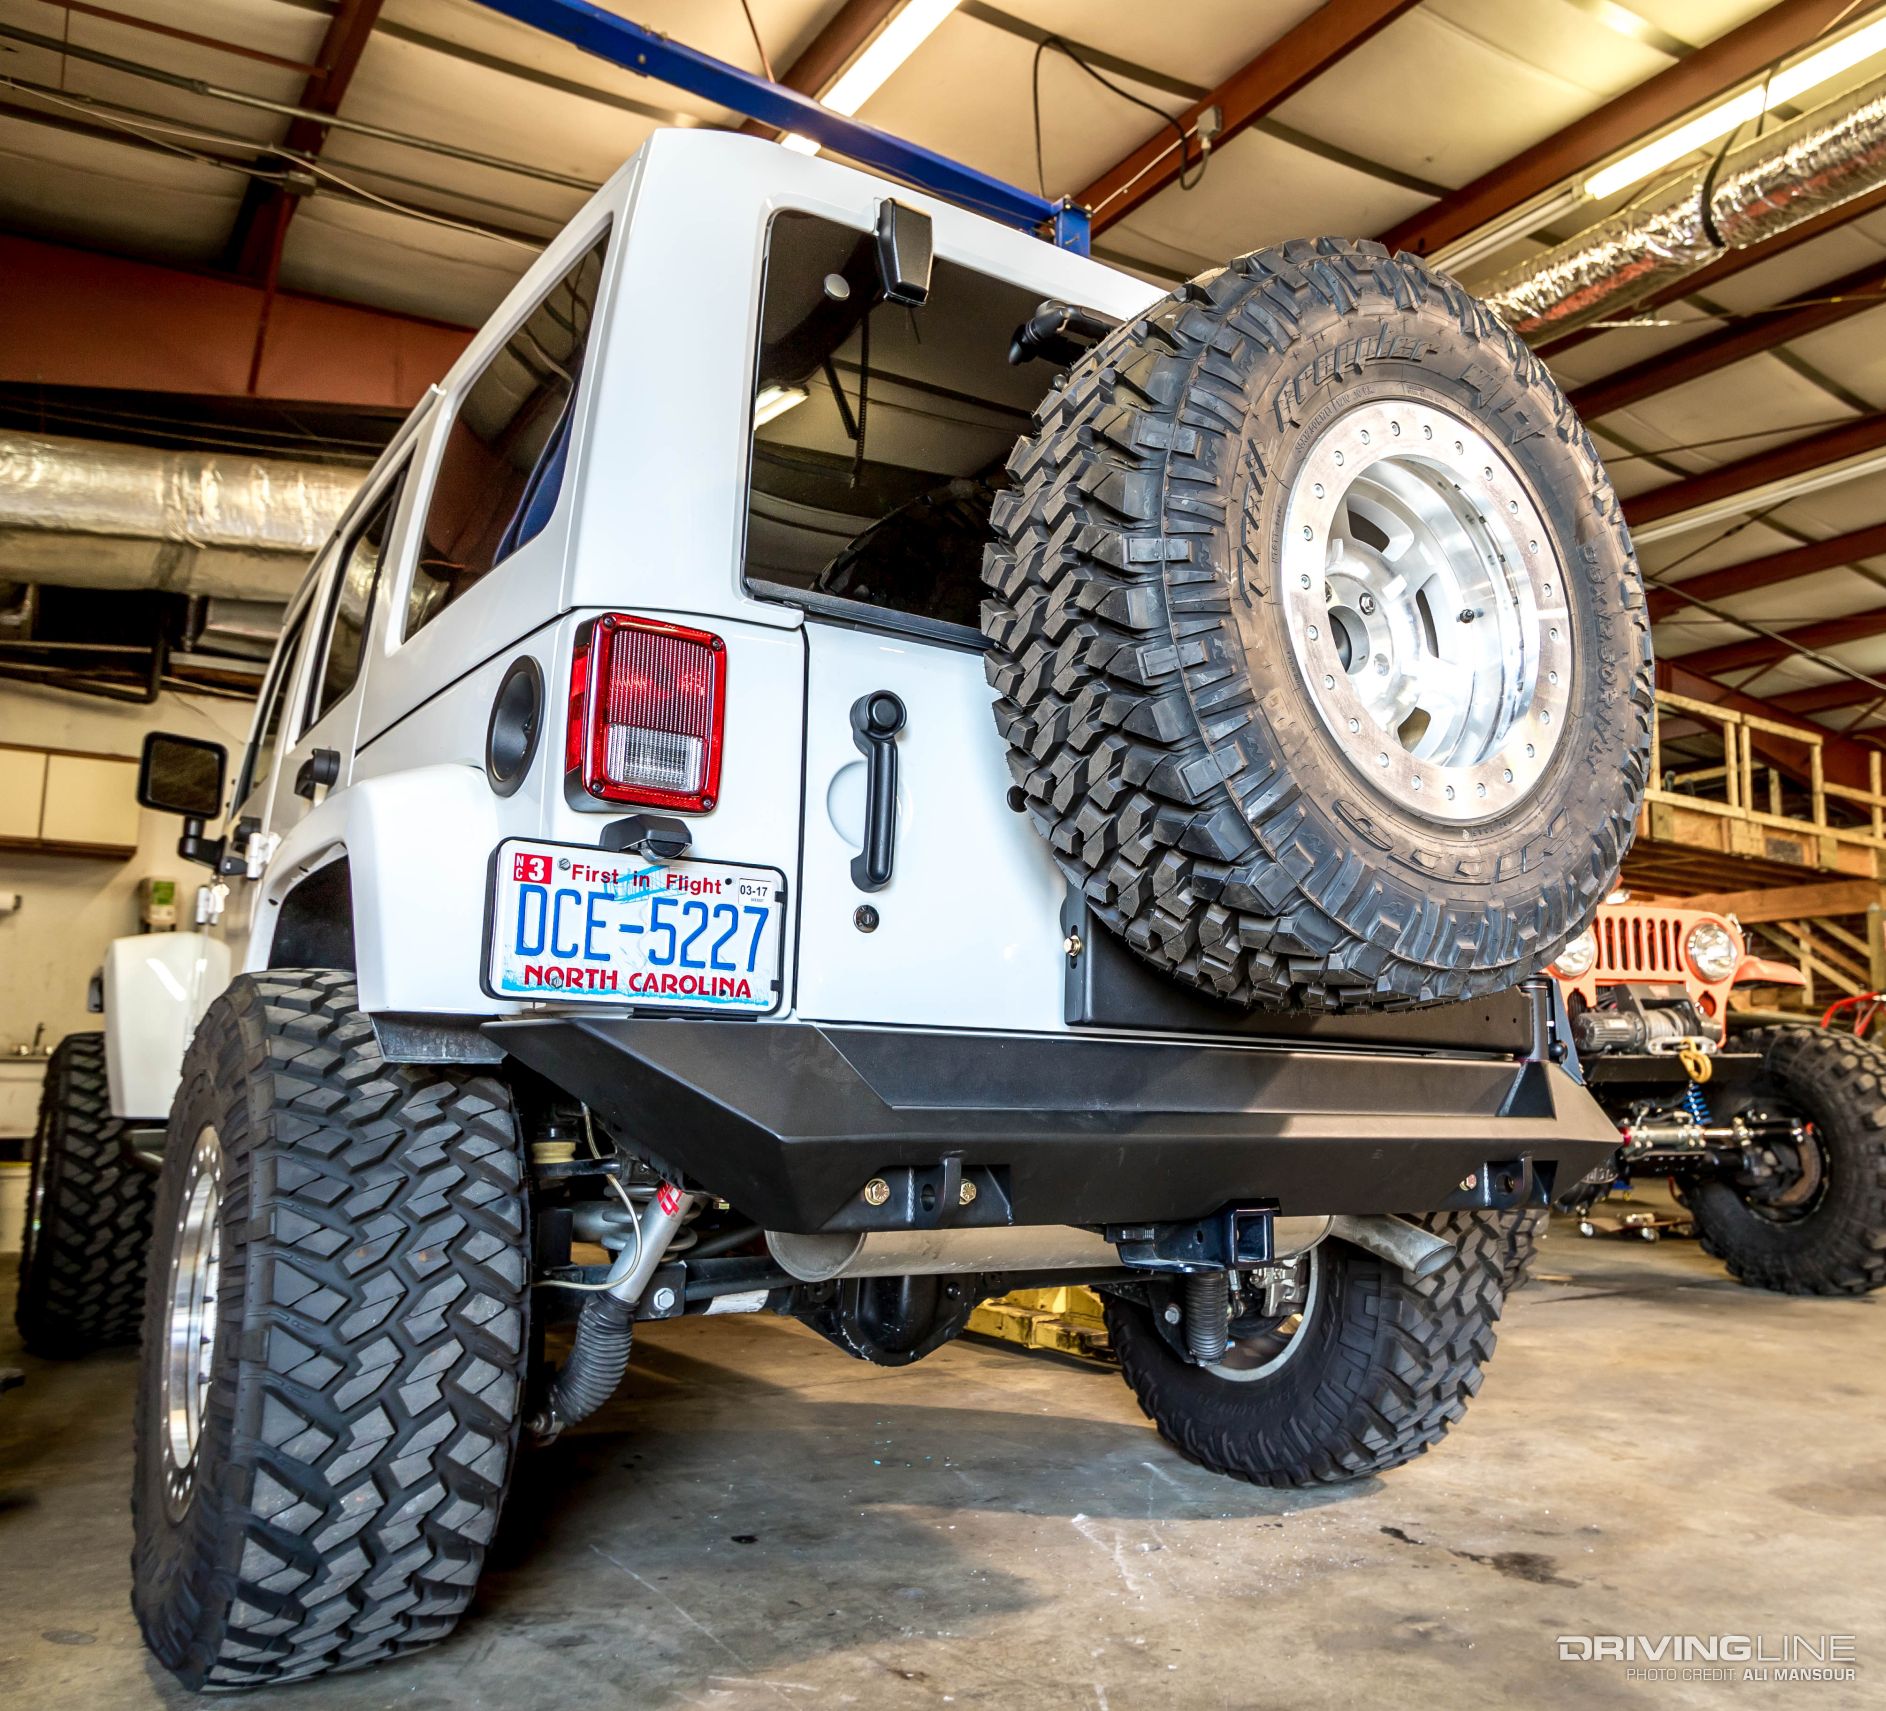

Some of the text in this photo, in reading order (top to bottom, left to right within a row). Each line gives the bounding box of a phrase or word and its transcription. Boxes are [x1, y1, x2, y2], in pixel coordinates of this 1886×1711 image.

[528, 857, 545, 881] 3
[571, 864, 722, 896] First in Flight
[740, 884, 768, 897] 03-17
[514, 884, 770, 973] DCE-5227
[524, 964, 752, 999] NORTH CAROLINA
